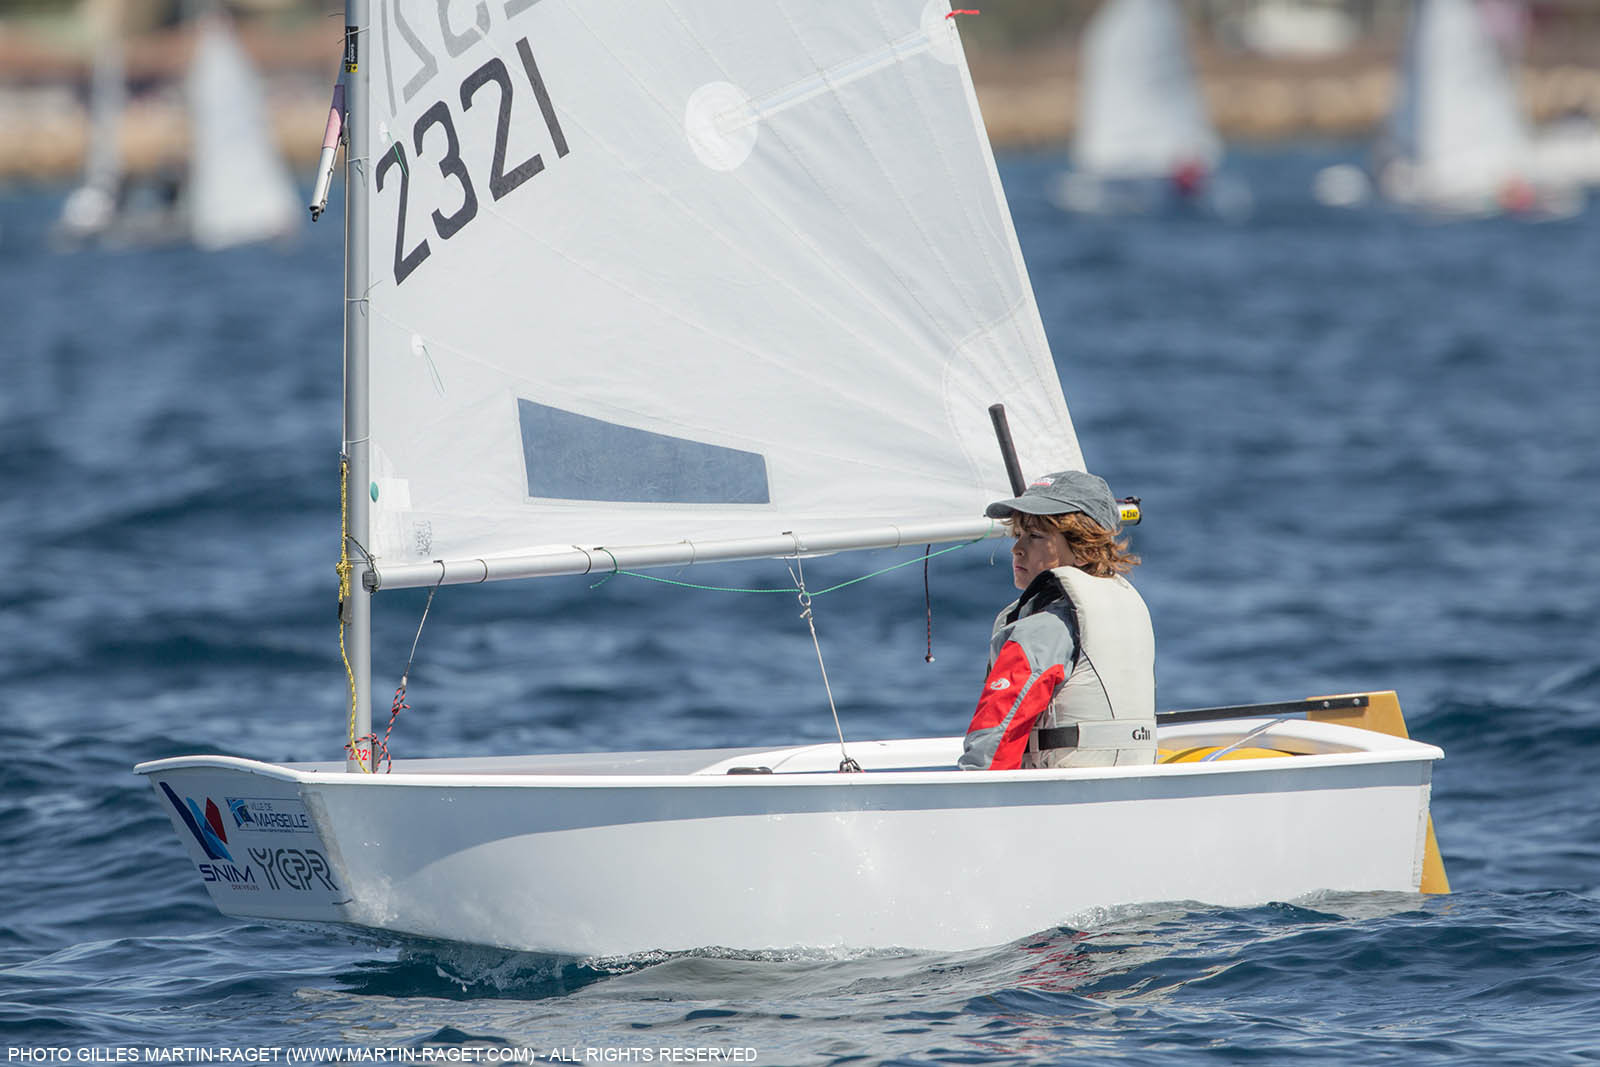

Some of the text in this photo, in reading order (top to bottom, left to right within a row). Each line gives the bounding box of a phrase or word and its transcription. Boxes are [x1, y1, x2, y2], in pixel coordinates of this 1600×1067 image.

[375, 36, 570, 286] 2321
[1132, 726, 1151, 741] Gill
[253, 812, 309, 828] MARSEILLE
[199, 864, 256, 883] SNIM
